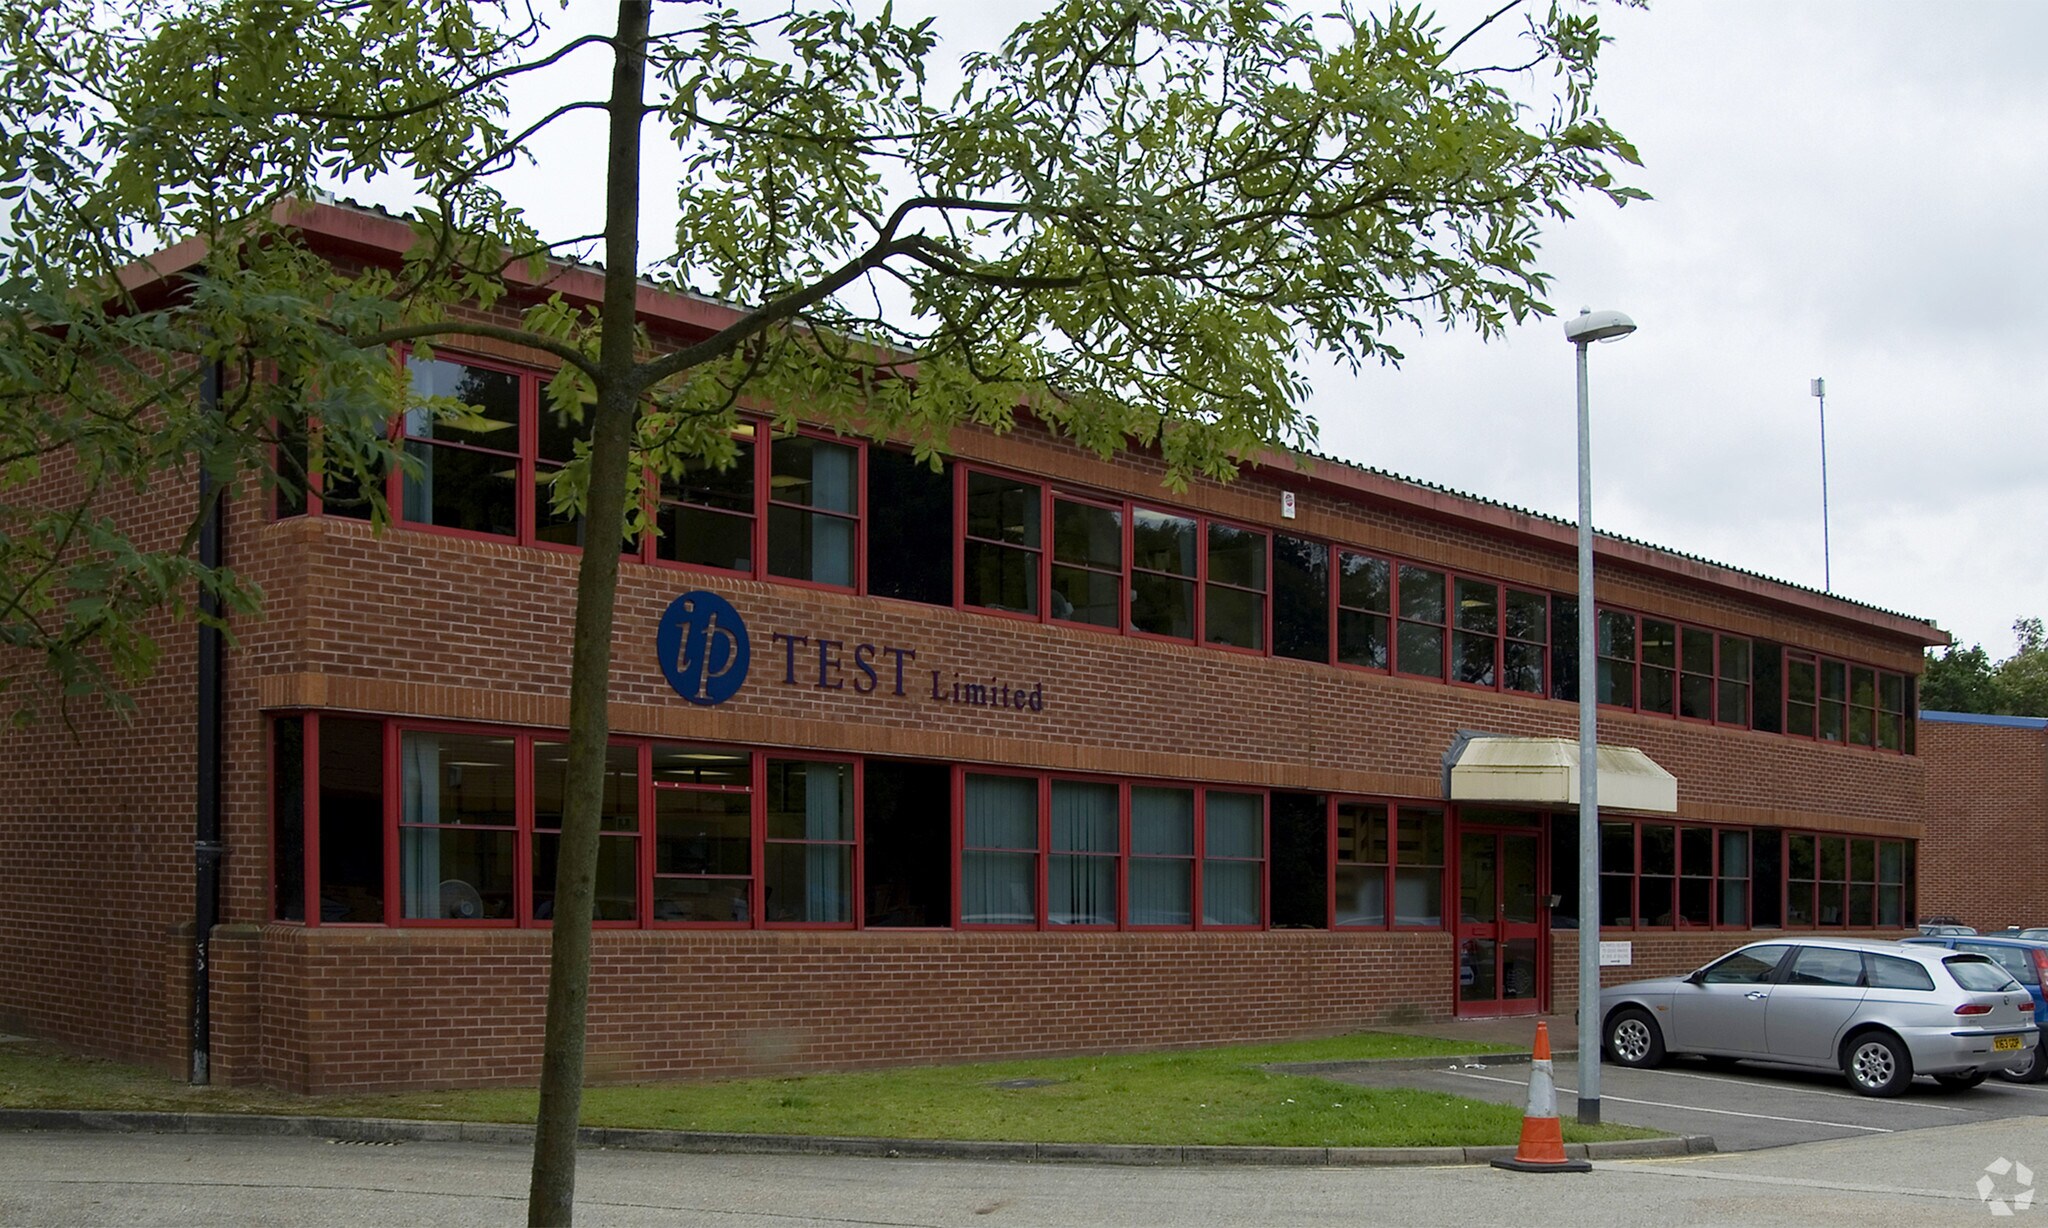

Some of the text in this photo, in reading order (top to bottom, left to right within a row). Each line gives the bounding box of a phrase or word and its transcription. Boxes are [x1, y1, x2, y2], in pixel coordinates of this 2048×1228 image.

[675, 599, 1044, 712] ip TEST Limited
